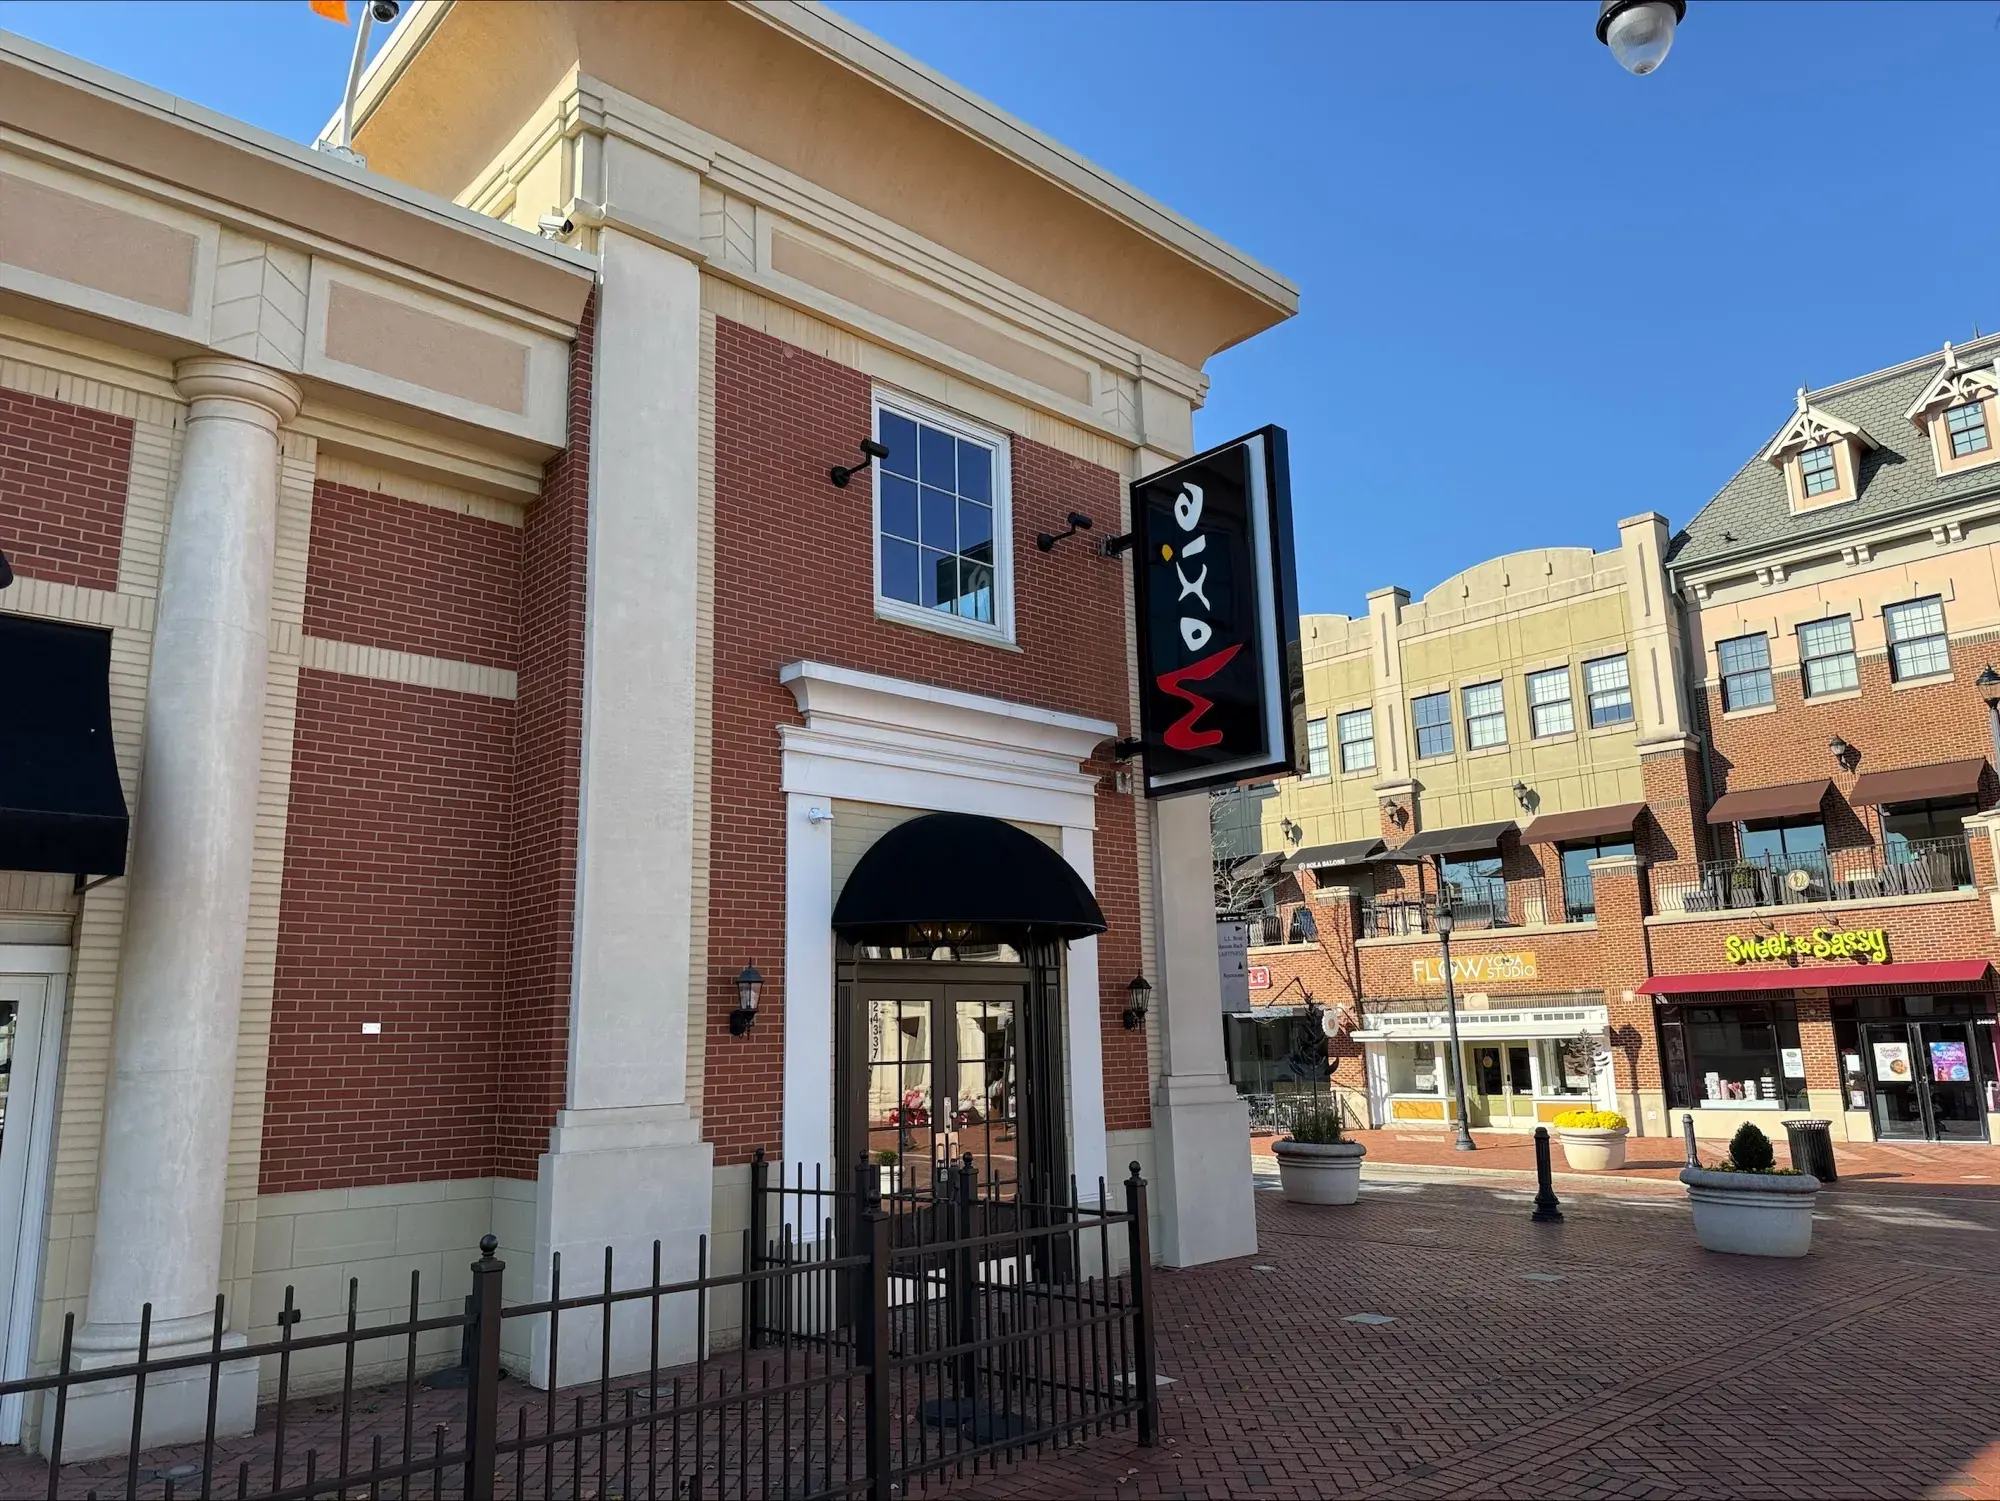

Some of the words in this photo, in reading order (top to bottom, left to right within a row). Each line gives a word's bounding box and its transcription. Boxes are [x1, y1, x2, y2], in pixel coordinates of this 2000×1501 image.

[1157, 482, 1244, 750] Moxie
[1306, 861, 1322, 869] SOLA
[1322, 858, 1346, 868] SALONS
[1725, 932, 1792, 963] Sweet
[1794, 936, 1811, 954] &
[1812, 927, 1887, 963] Sassy
[1413, 958, 1484, 982] FLOW
[1485, 954, 1523, 967] YOGA
[1487, 965, 1536, 979] STUDIO
